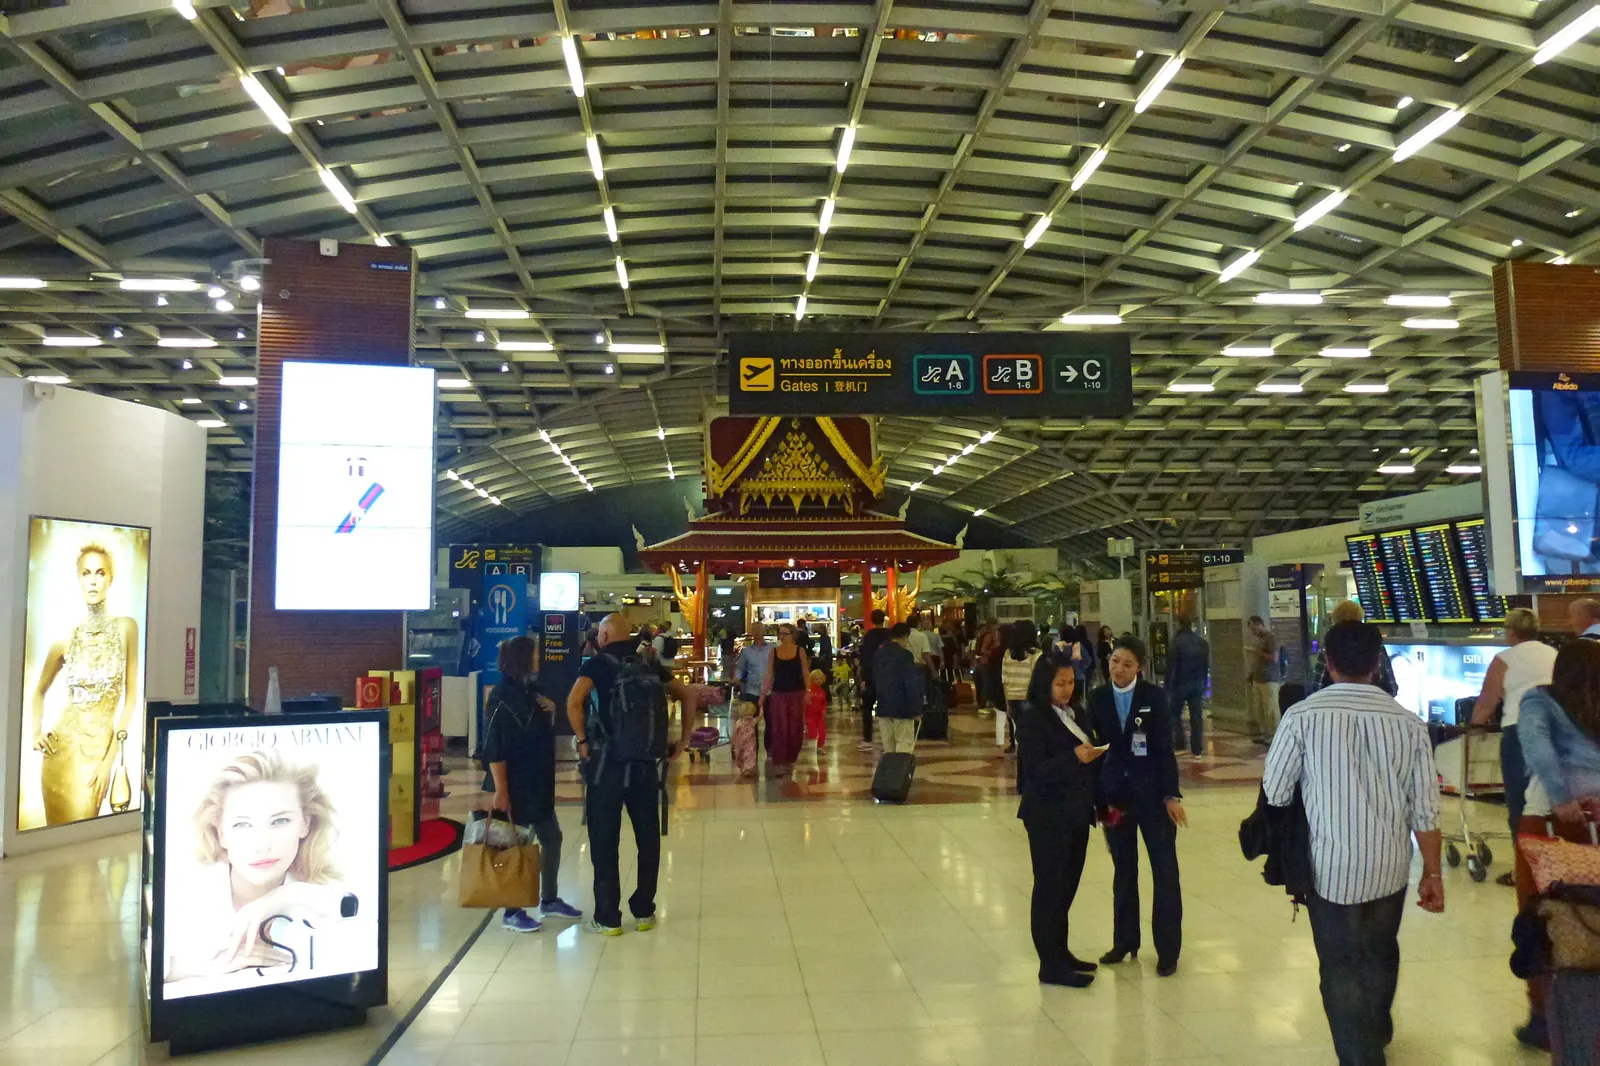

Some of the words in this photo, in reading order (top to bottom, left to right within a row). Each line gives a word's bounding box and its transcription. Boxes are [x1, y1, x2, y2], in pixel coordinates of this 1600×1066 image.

[780, 349, 892, 369] ทางออกขึ้นเครื่อง
[945, 359, 964, 381] A
[1016, 359, 1033, 381] B
[1082, 359, 1101, 380] C
[780, 380, 819, 392] Gates
[834, 381, 868, 393] 登机门
[947, 381, 962, 390] 1-6
[1017, 381, 1031, 390] 1-6
[1083, 381, 1101, 389] 1-10
[1203, 555, 1211, 563] C
[1212, 554, 1231, 563] 1-10
[491, 565, 501, 575] A
[781, 570, 817, 581] OTOP
[545, 639, 564, 647] Free
[545, 653, 564, 661] Here
[188, 731, 277, 750] GIORGIO
[291, 726, 362, 746] ARMANI
